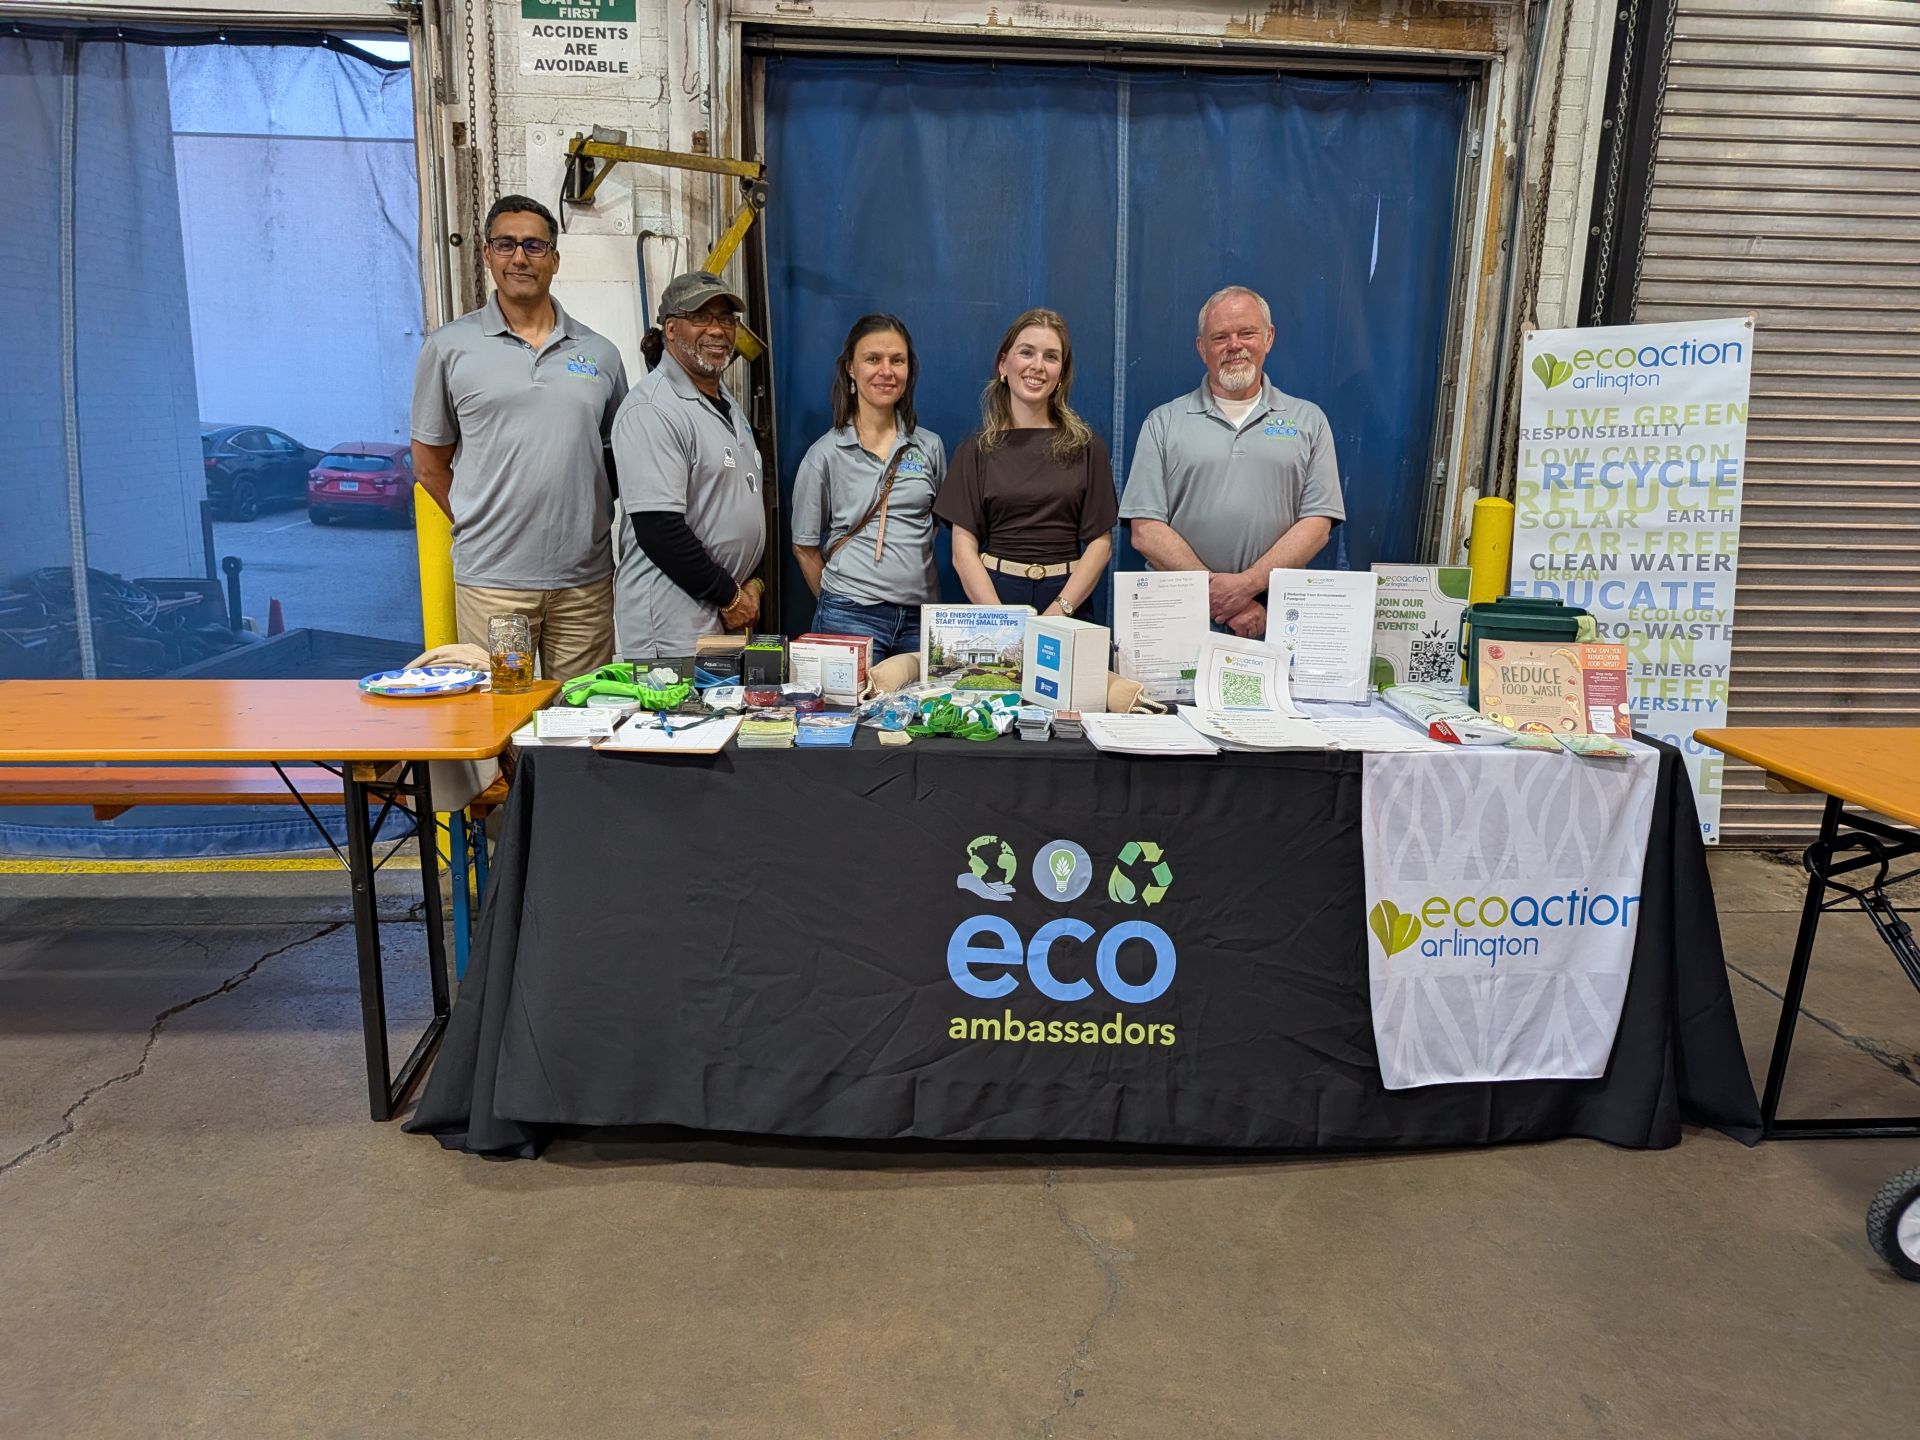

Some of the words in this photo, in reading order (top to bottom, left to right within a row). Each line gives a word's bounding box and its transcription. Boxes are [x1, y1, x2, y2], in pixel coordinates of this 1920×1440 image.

[559, 8, 600, 19] FIRST
[532, 25, 628, 40] ACCIDENTS
[564, 43, 598, 56] ARE
[534, 59, 629, 74] AVOIDABLE
[1572, 338, 1742, 371] ecoaction
[1572, 369, 1660, 396] arlington
[1547, 406, 1621, 430] LIVE
[1634, 402, 1748, 428] GREEN
[1520, 423, 1686, 441] RESPONSIBILITY
[1524, 447, 1590, 468] LOW
[1602, 444, 1730, 466] CARBON
[1543, 459, 1739, 490] RECYCLE
[1515, 476, 1736, 515] REDUCE
[1520, 509, 1640, 530] SOLAR
[1667, 509, 1734, 523] EARTH
[1548, 530, 1738, 556] CAR-FREE
[1529, 553, 1618, 572] CLEAN
[1631, 553, 1732, 572] WATER
[1534, 568, 1600, 581] URBAN
[1376, 598, 1400, 607] JOIN
[1402, 598, 1424, 607] OUR
[1628, 608, 1727, 622] ECOLOGY
[1376, 621, 1419, 632] EVENTS!
[1501, 666, 1562, 685] REDUCE
[1642, 662, 1728, 678] ENERGY
[1502, 683, 1528, 695] FOOD
[1531, 684, 1562, 697] WASTE
[1421, 928, 1539, 968] arlington
[946, 914, 1177, 1004] eco
[949, 1008, 1177, 1046] ambassadors
